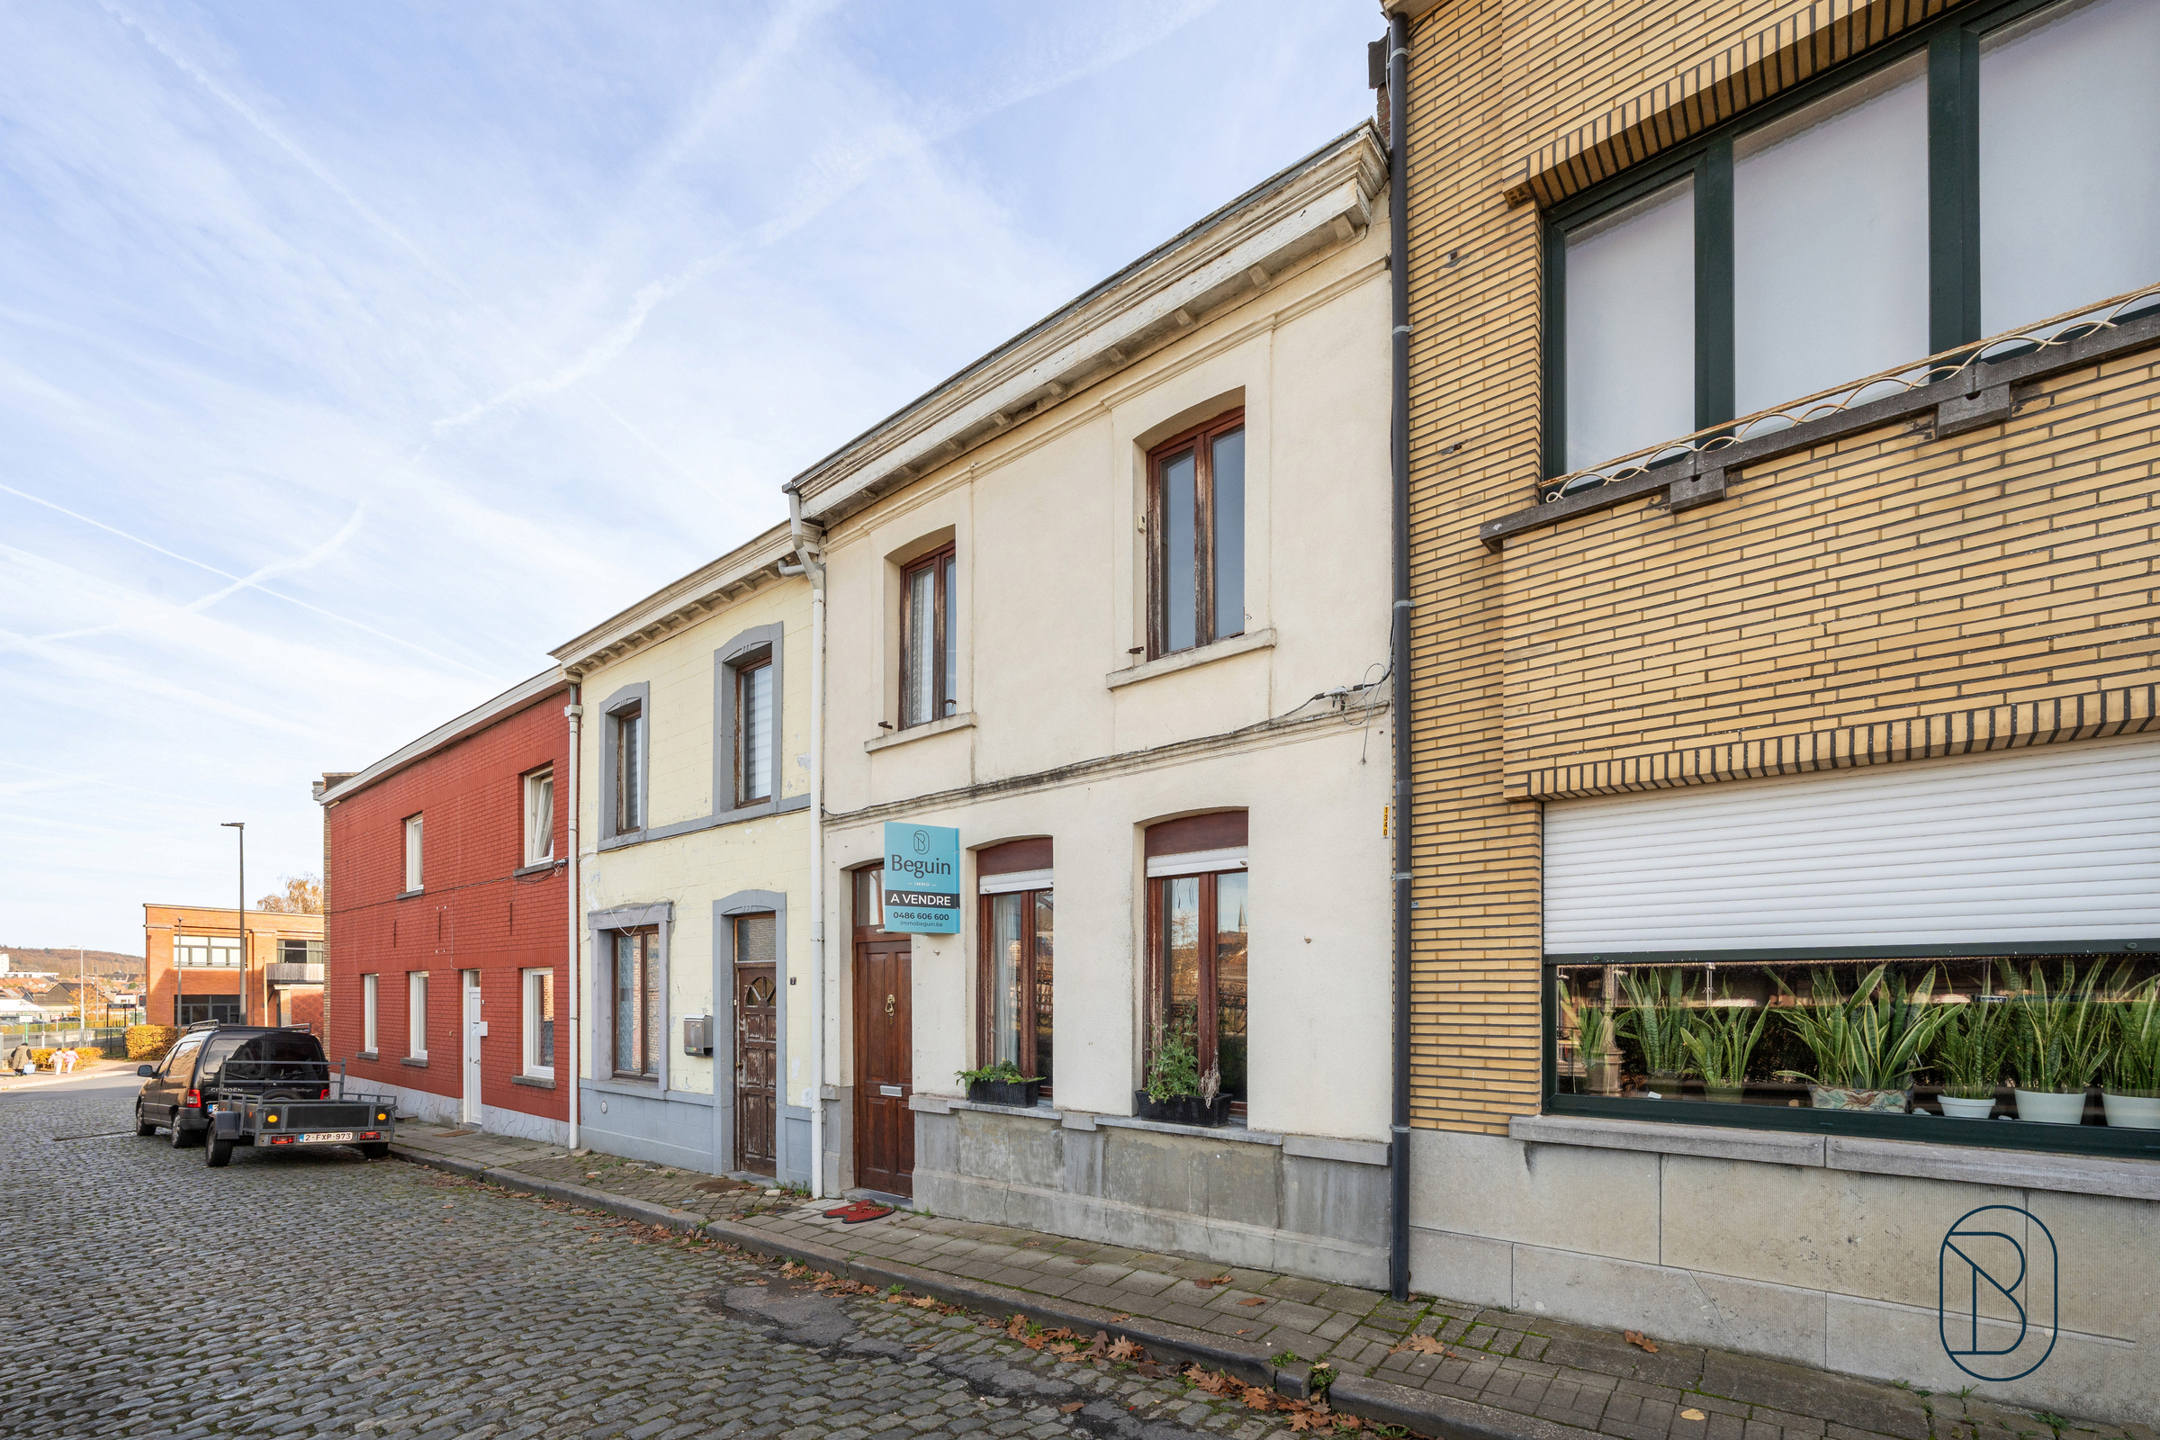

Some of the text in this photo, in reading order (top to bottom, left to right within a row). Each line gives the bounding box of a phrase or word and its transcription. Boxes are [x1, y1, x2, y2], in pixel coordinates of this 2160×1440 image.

[891, 854, 951, 879] Beguin
[890, 893, 951, 906] A VENDRE
[917, 912, 932, 920] 606
[934, 913, 950, 921] 600
[305, 1133, 351, 1141] 2-FXP-973
